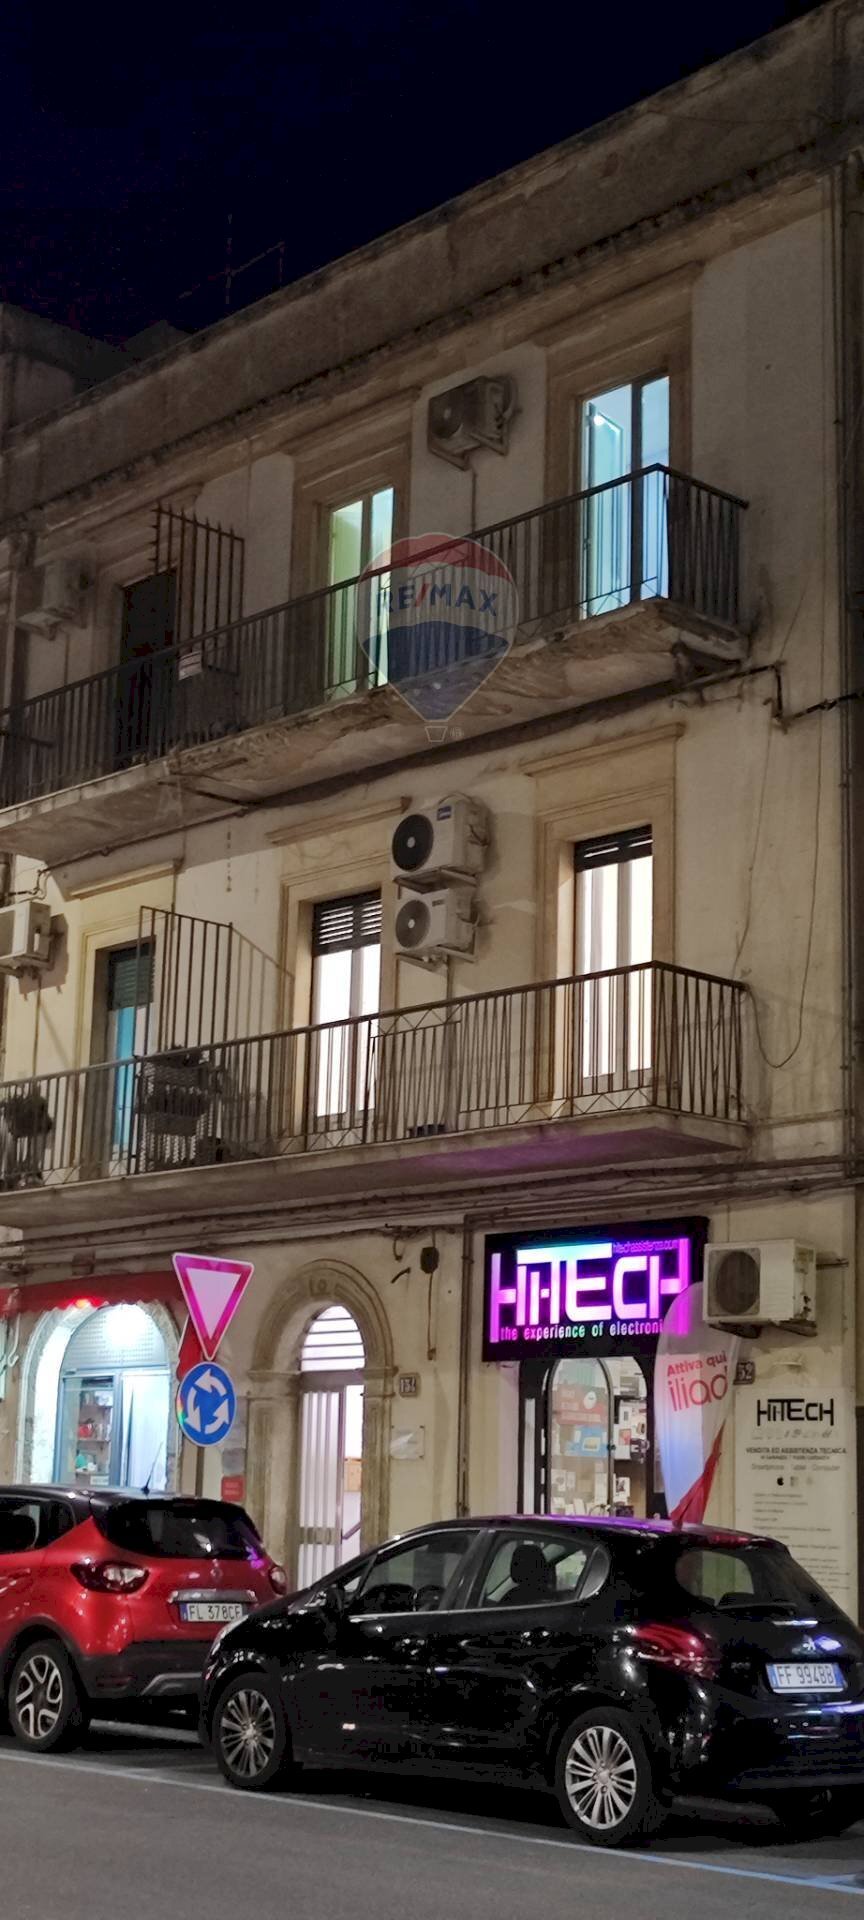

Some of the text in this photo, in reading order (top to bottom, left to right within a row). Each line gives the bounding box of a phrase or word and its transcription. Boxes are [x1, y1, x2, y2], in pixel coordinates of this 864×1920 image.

[500, 1319, 664, 1342] the experience of electroni
[667, 1350, 728, 1377] Attiva qui
[667, 1365, 728, 1412] iliad
[188, 1605, 204, 1620] FL
[777, 1665, 792, 1685] FF
